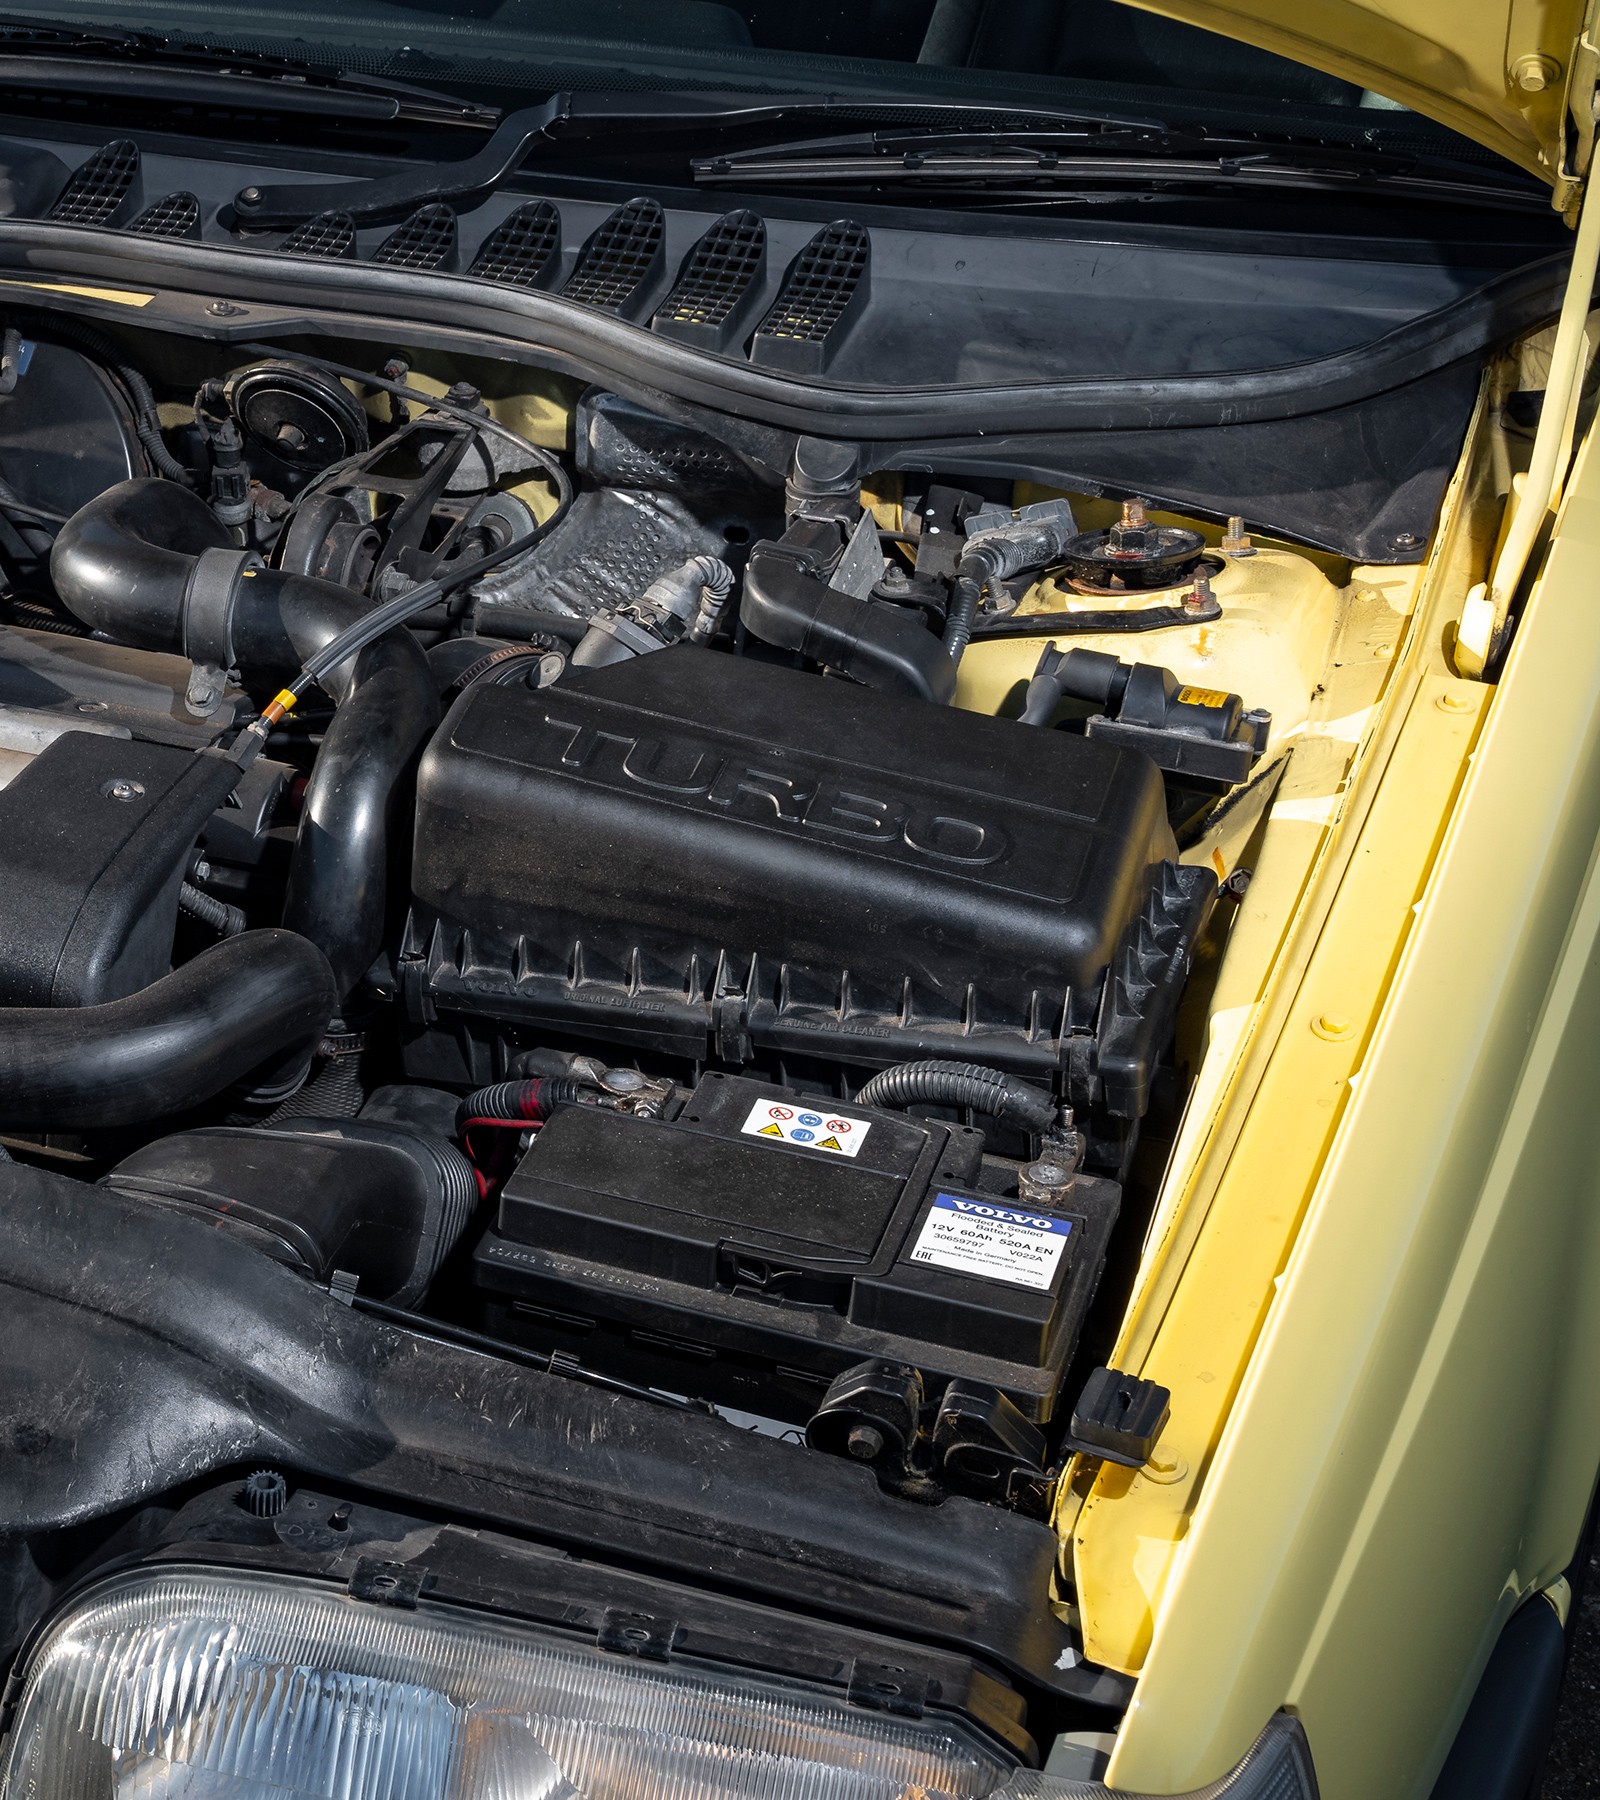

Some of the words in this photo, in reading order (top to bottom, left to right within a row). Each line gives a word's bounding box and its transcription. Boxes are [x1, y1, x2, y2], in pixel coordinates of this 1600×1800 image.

[545, 713, 1010, 866] TURBO
[463, 979, 540, 998] VOLVO
[563, 991, 607, 1005] ORIGINAL
[820, 1021, 840, 1033] AIR
[841, 1024, 891, 1038] CLEANER
[951, 1199, 1053, 1230] VOLVO
[951, 1212, 993, 1227] Flooded
[994, 1221, 1004, 1229] &
[1006, 1225, 1044, 1238] Sealed
[975, 1224, 1015, 1238] Battery
[931, 1223, 955, 1233] 12V
[960, 1229, 993, 1242] 60Ah
[999, 1238, 1031, 1251] 520A
[1035, 1246, 1054, 1256] EN
[933, 1232, 985, 1248] 30659797
[1009, 1249, 1044, 1262] V022A
[922, 1245, 961, 1259] MAINTENANCE
[962, 1254, 977, 1262] FREE
[954, 1245, 974, 1254] Made
[984, 1252, 1017, 1264] Germany
